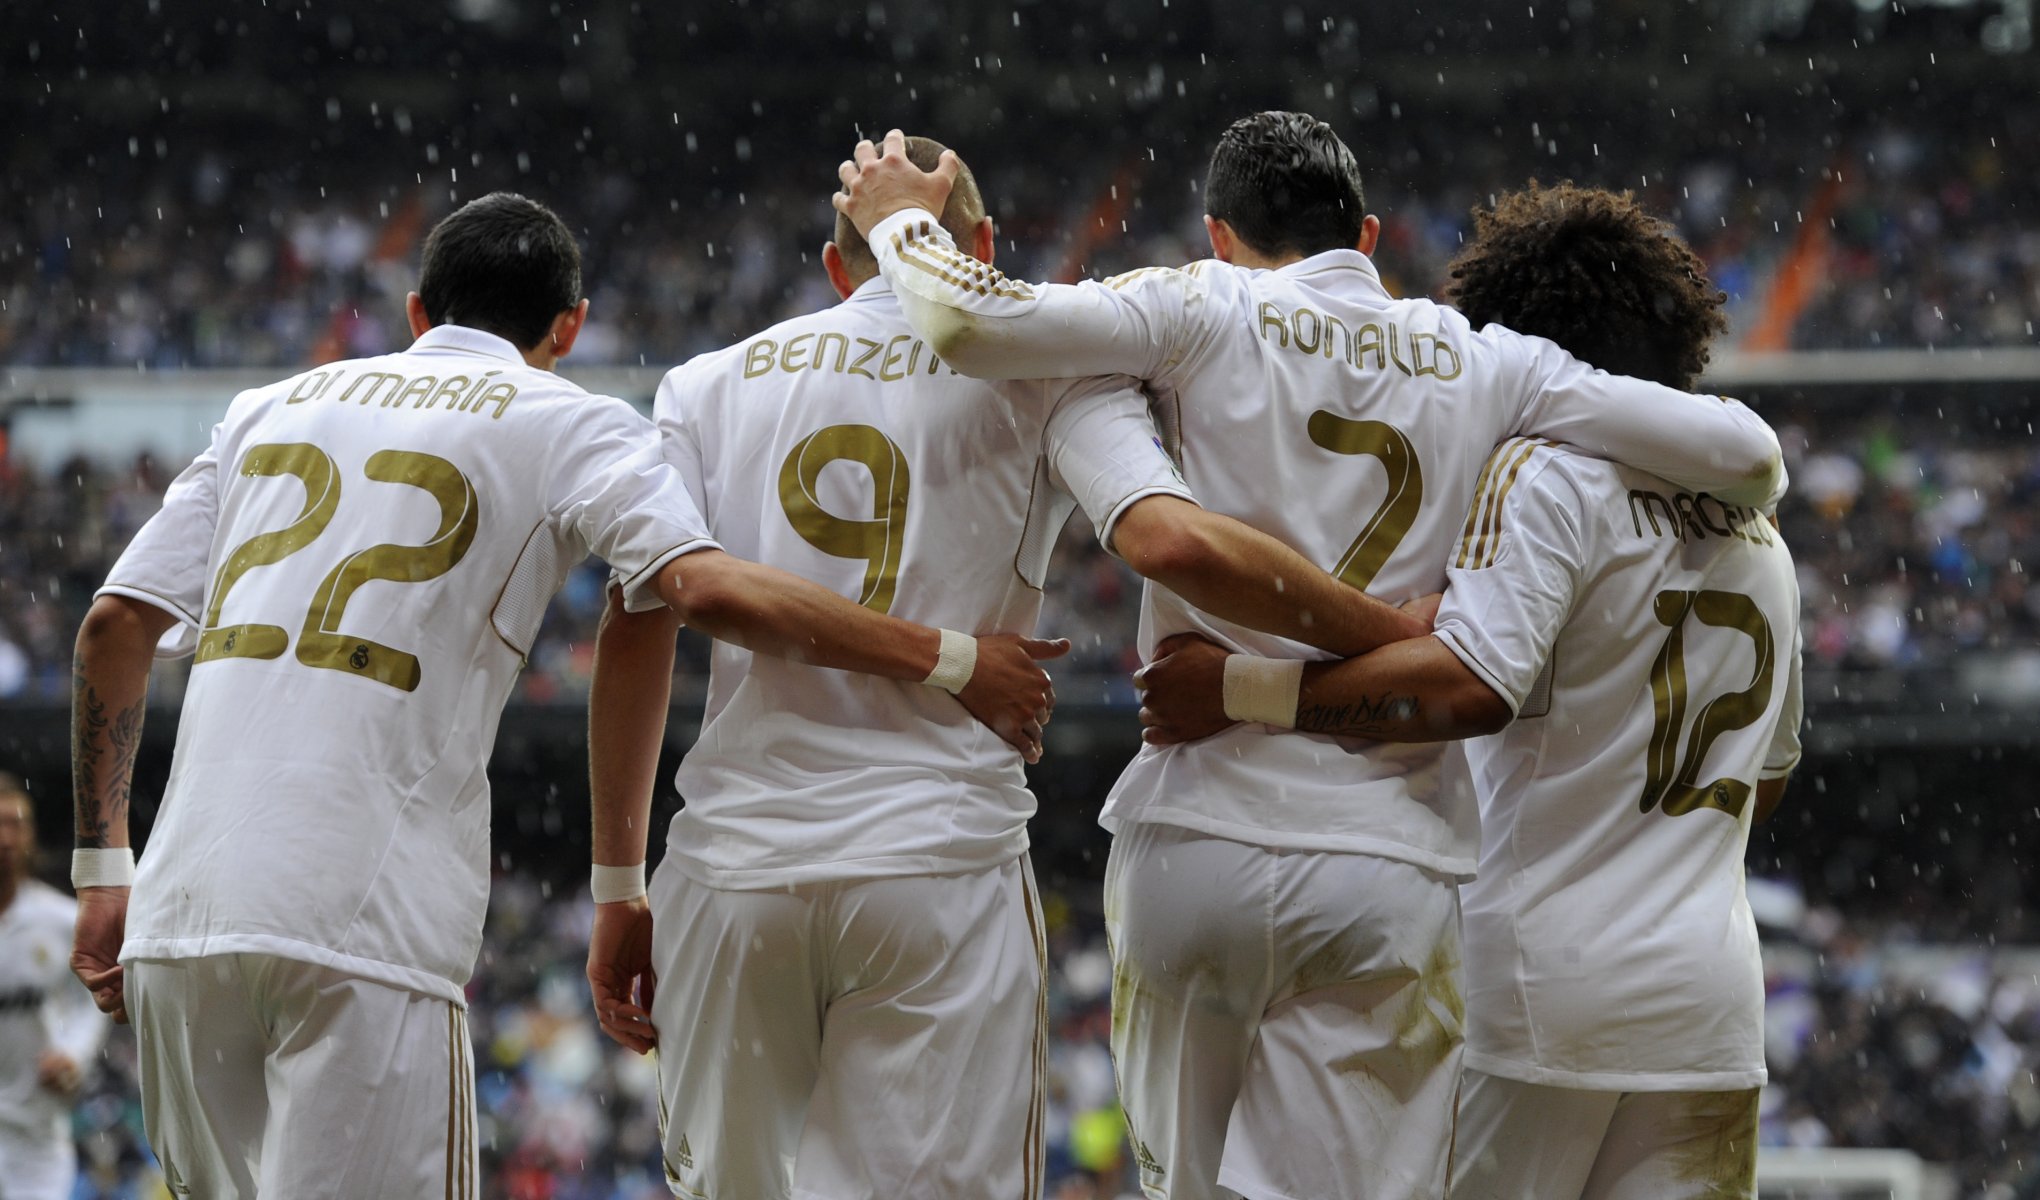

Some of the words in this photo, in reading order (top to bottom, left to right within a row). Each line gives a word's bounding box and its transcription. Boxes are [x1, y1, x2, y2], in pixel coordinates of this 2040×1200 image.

[286, 369, 346, 405] DI
[338, 370, 518, 420] MARÍA
[1258, 301, 1463, 381] RONALDO
[192, 442, 480, 693] 22
[777, 423, 911, 615] 9
[1307, 409, 1424, 593] 7
[1639, 589, 1775, 819] 12
